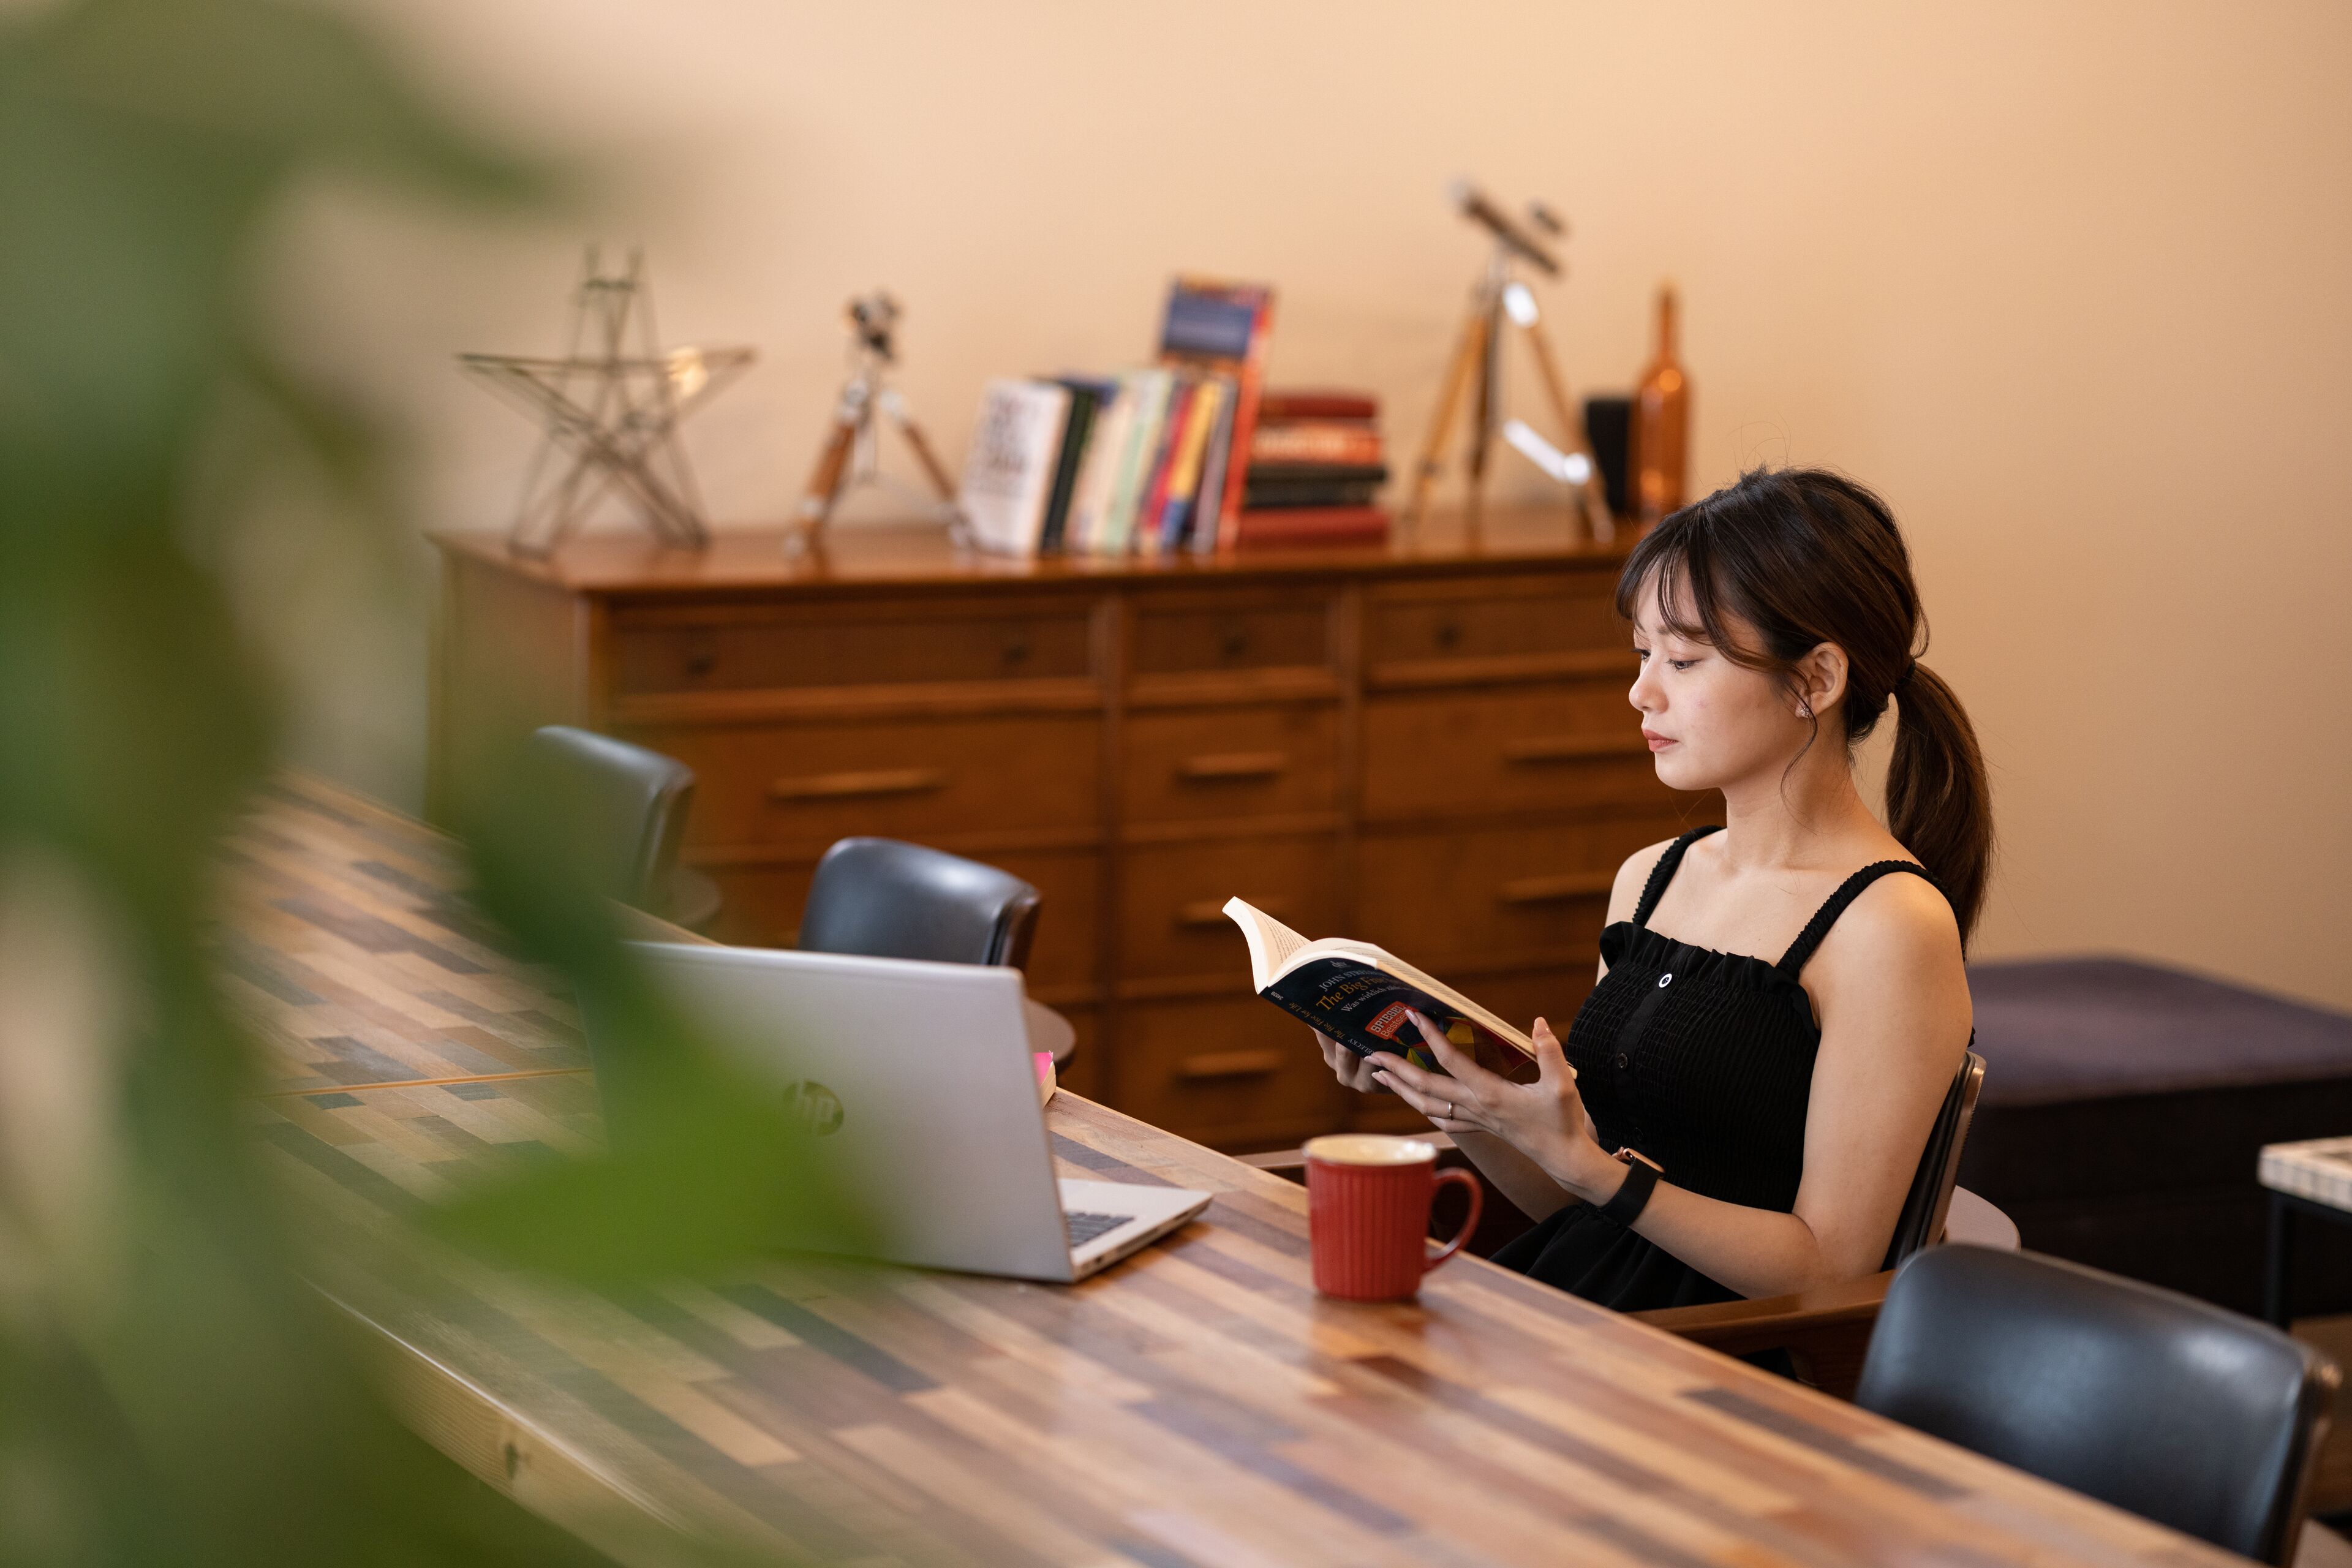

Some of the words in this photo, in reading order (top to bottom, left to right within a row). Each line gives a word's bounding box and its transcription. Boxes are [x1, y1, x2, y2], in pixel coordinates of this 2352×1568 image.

[1316, 992, 1344, 1010] The
[1340, 981, 1368, 994] Big
[1319, 974, 1345, 992] JOHN
[1341, 1000, 1360, 1012] Was
[1359, 987, 1387, 1002] wirklich
[1370, 1005, 1407, 1033] SPIEGEL
[1334, 1030, 1346, 1039] The
